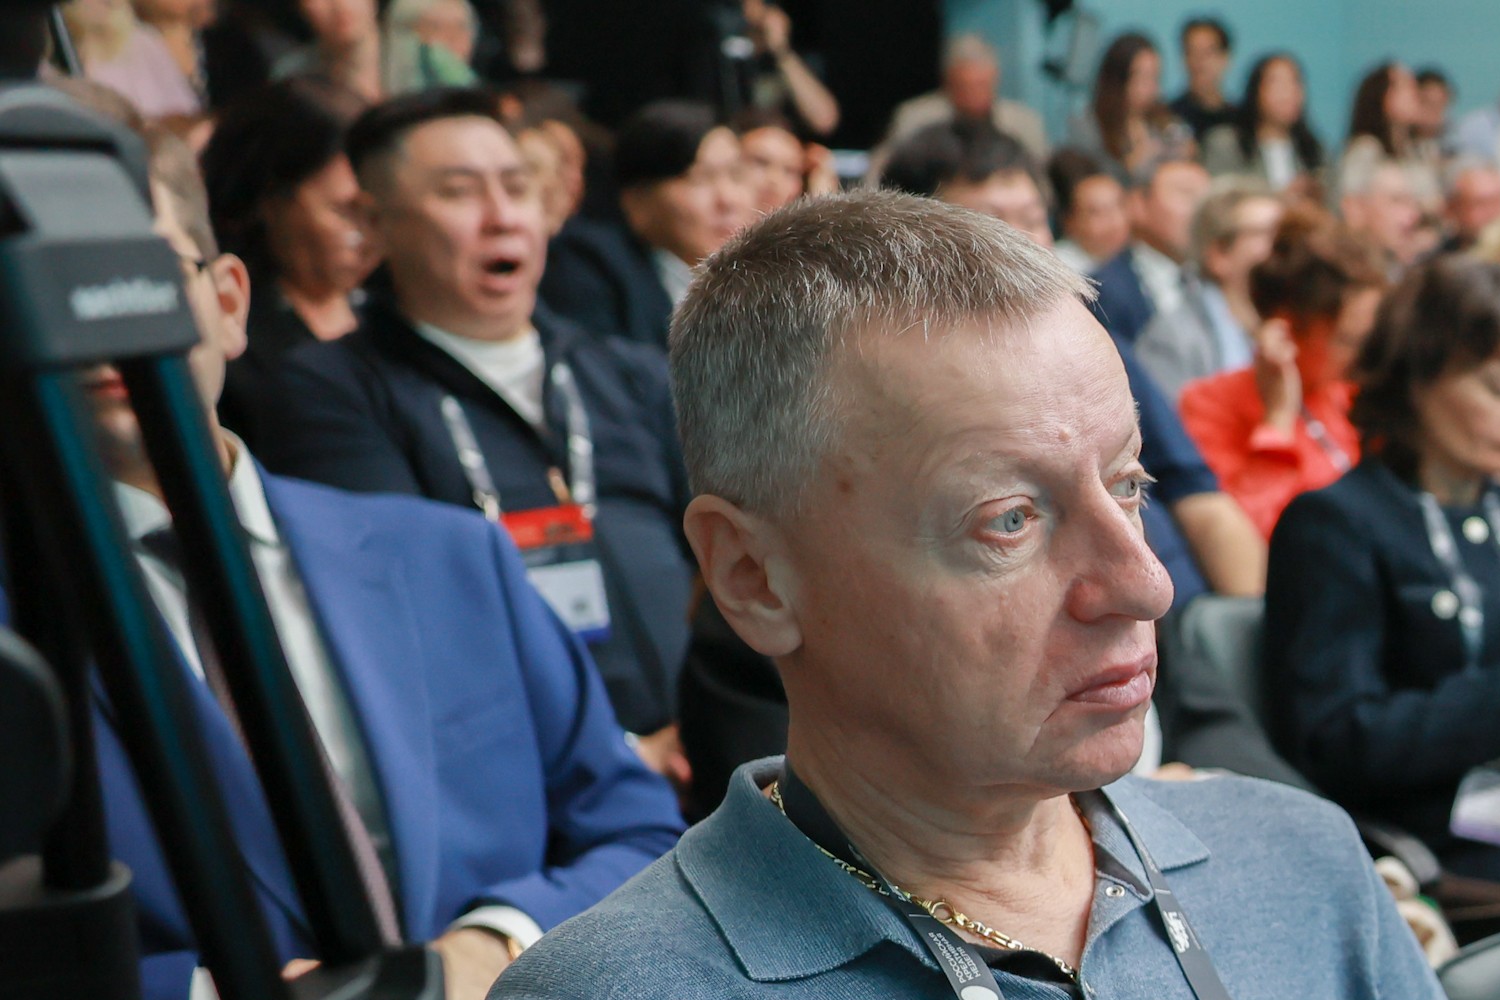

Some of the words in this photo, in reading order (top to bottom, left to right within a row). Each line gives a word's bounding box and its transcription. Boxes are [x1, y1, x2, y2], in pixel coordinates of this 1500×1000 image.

[927, 930, 967, 984] РОССИЙСКАЯ
[935, 932, 974, 981] КРЕАТИВНАЯ
[955, 945, 981, 978] НЕДЕЛЯ
